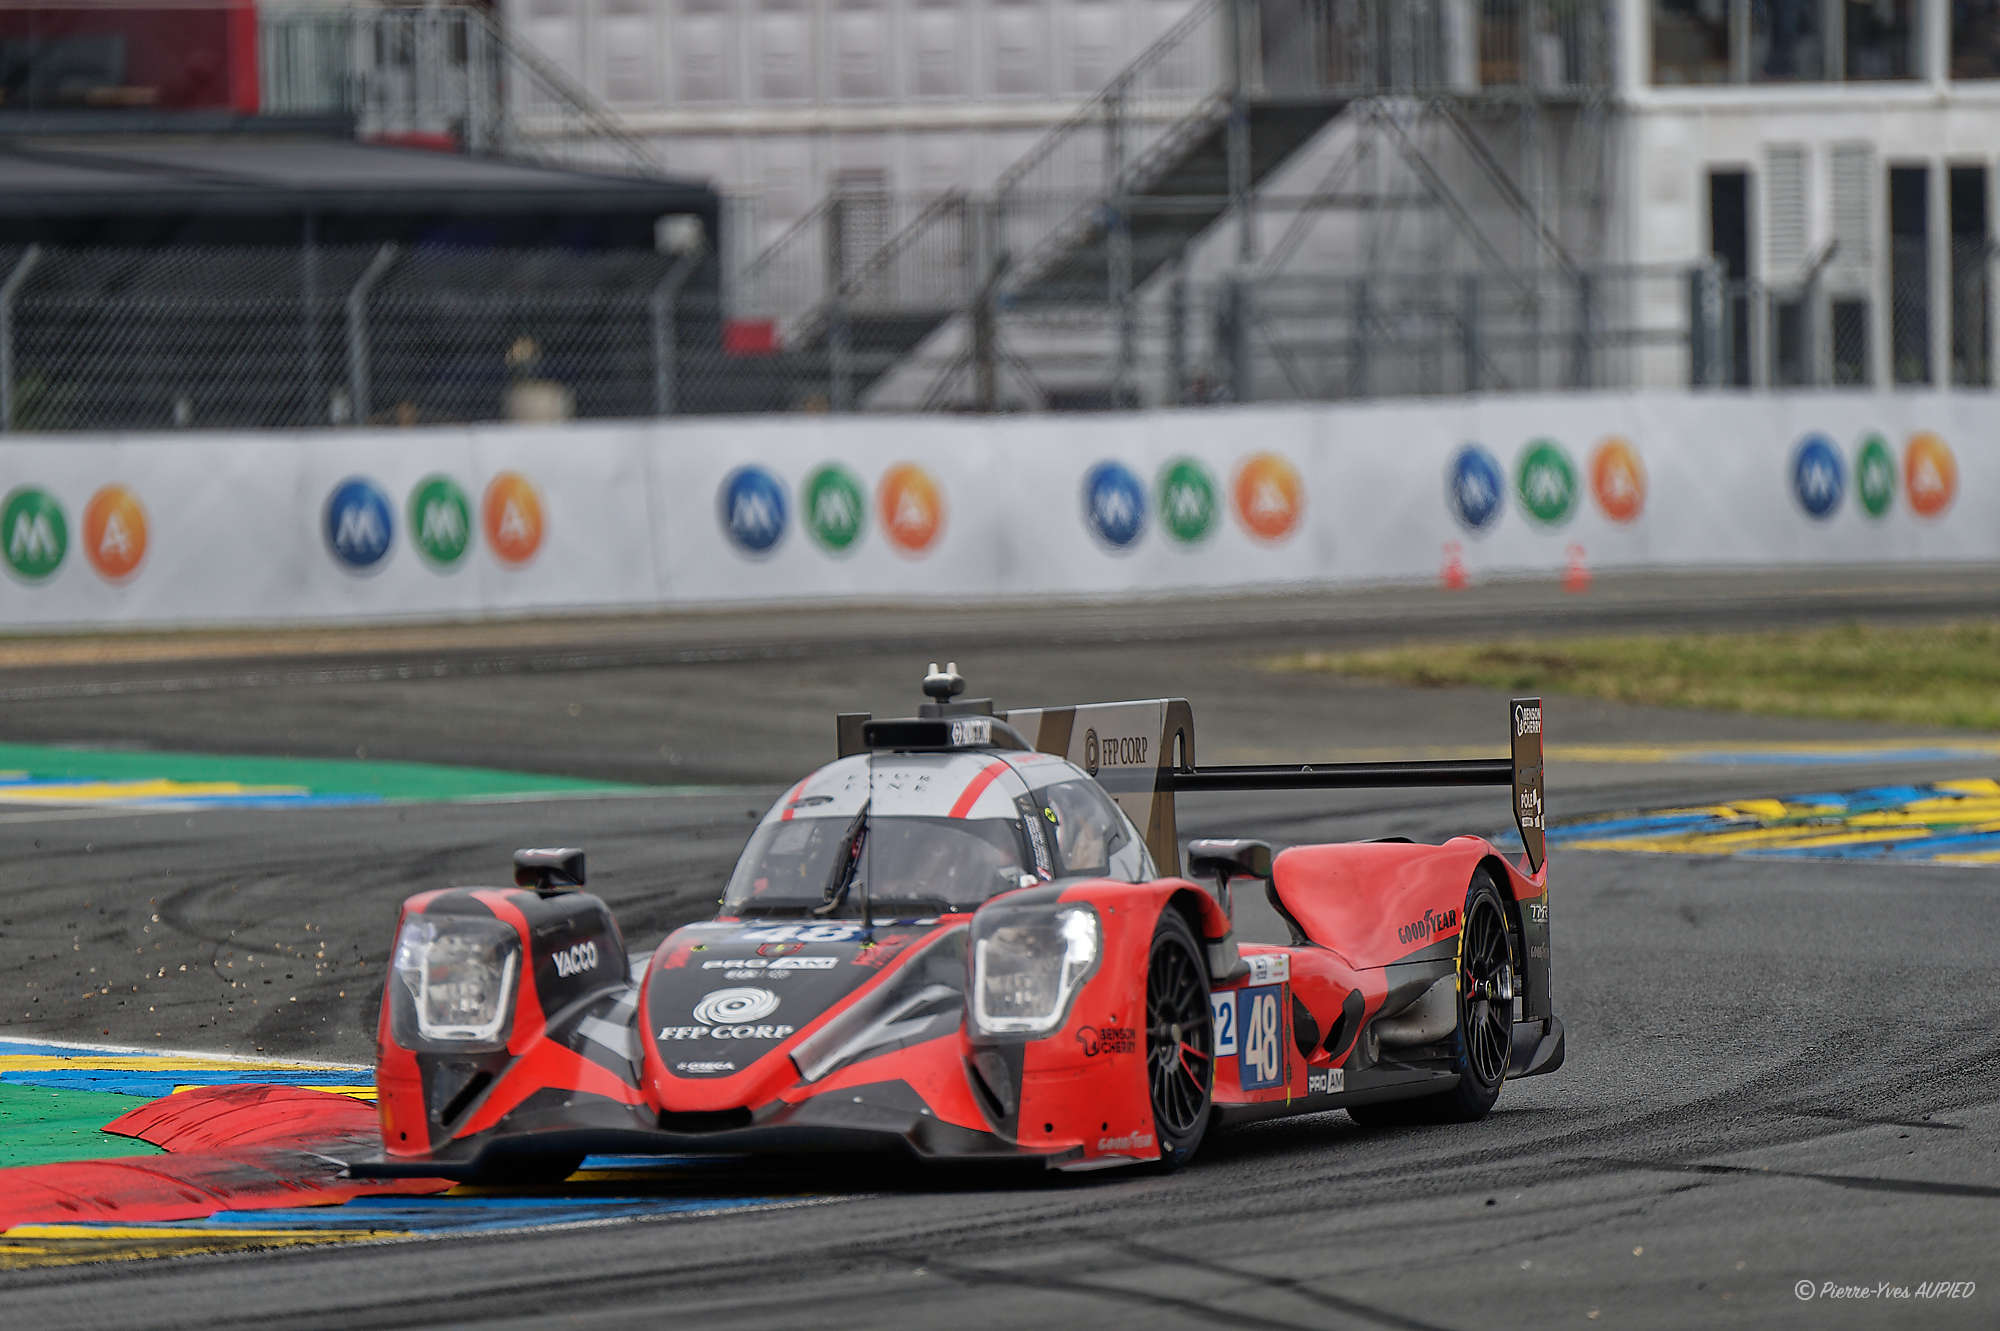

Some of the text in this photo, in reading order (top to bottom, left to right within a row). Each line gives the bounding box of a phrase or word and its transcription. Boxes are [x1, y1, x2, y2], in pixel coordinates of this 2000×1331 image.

[1102, 736, 1148, 765] FFP CORP
[1398, 908, 1456, 944] GOODYEAR
[551, 941, 599, 977] YACCO
[658, 1024, 794, 1040] FFP CORP
[1245, 994, 1278, 1082] 48
[1309, 1070, 1344, 1092] PRO AM
